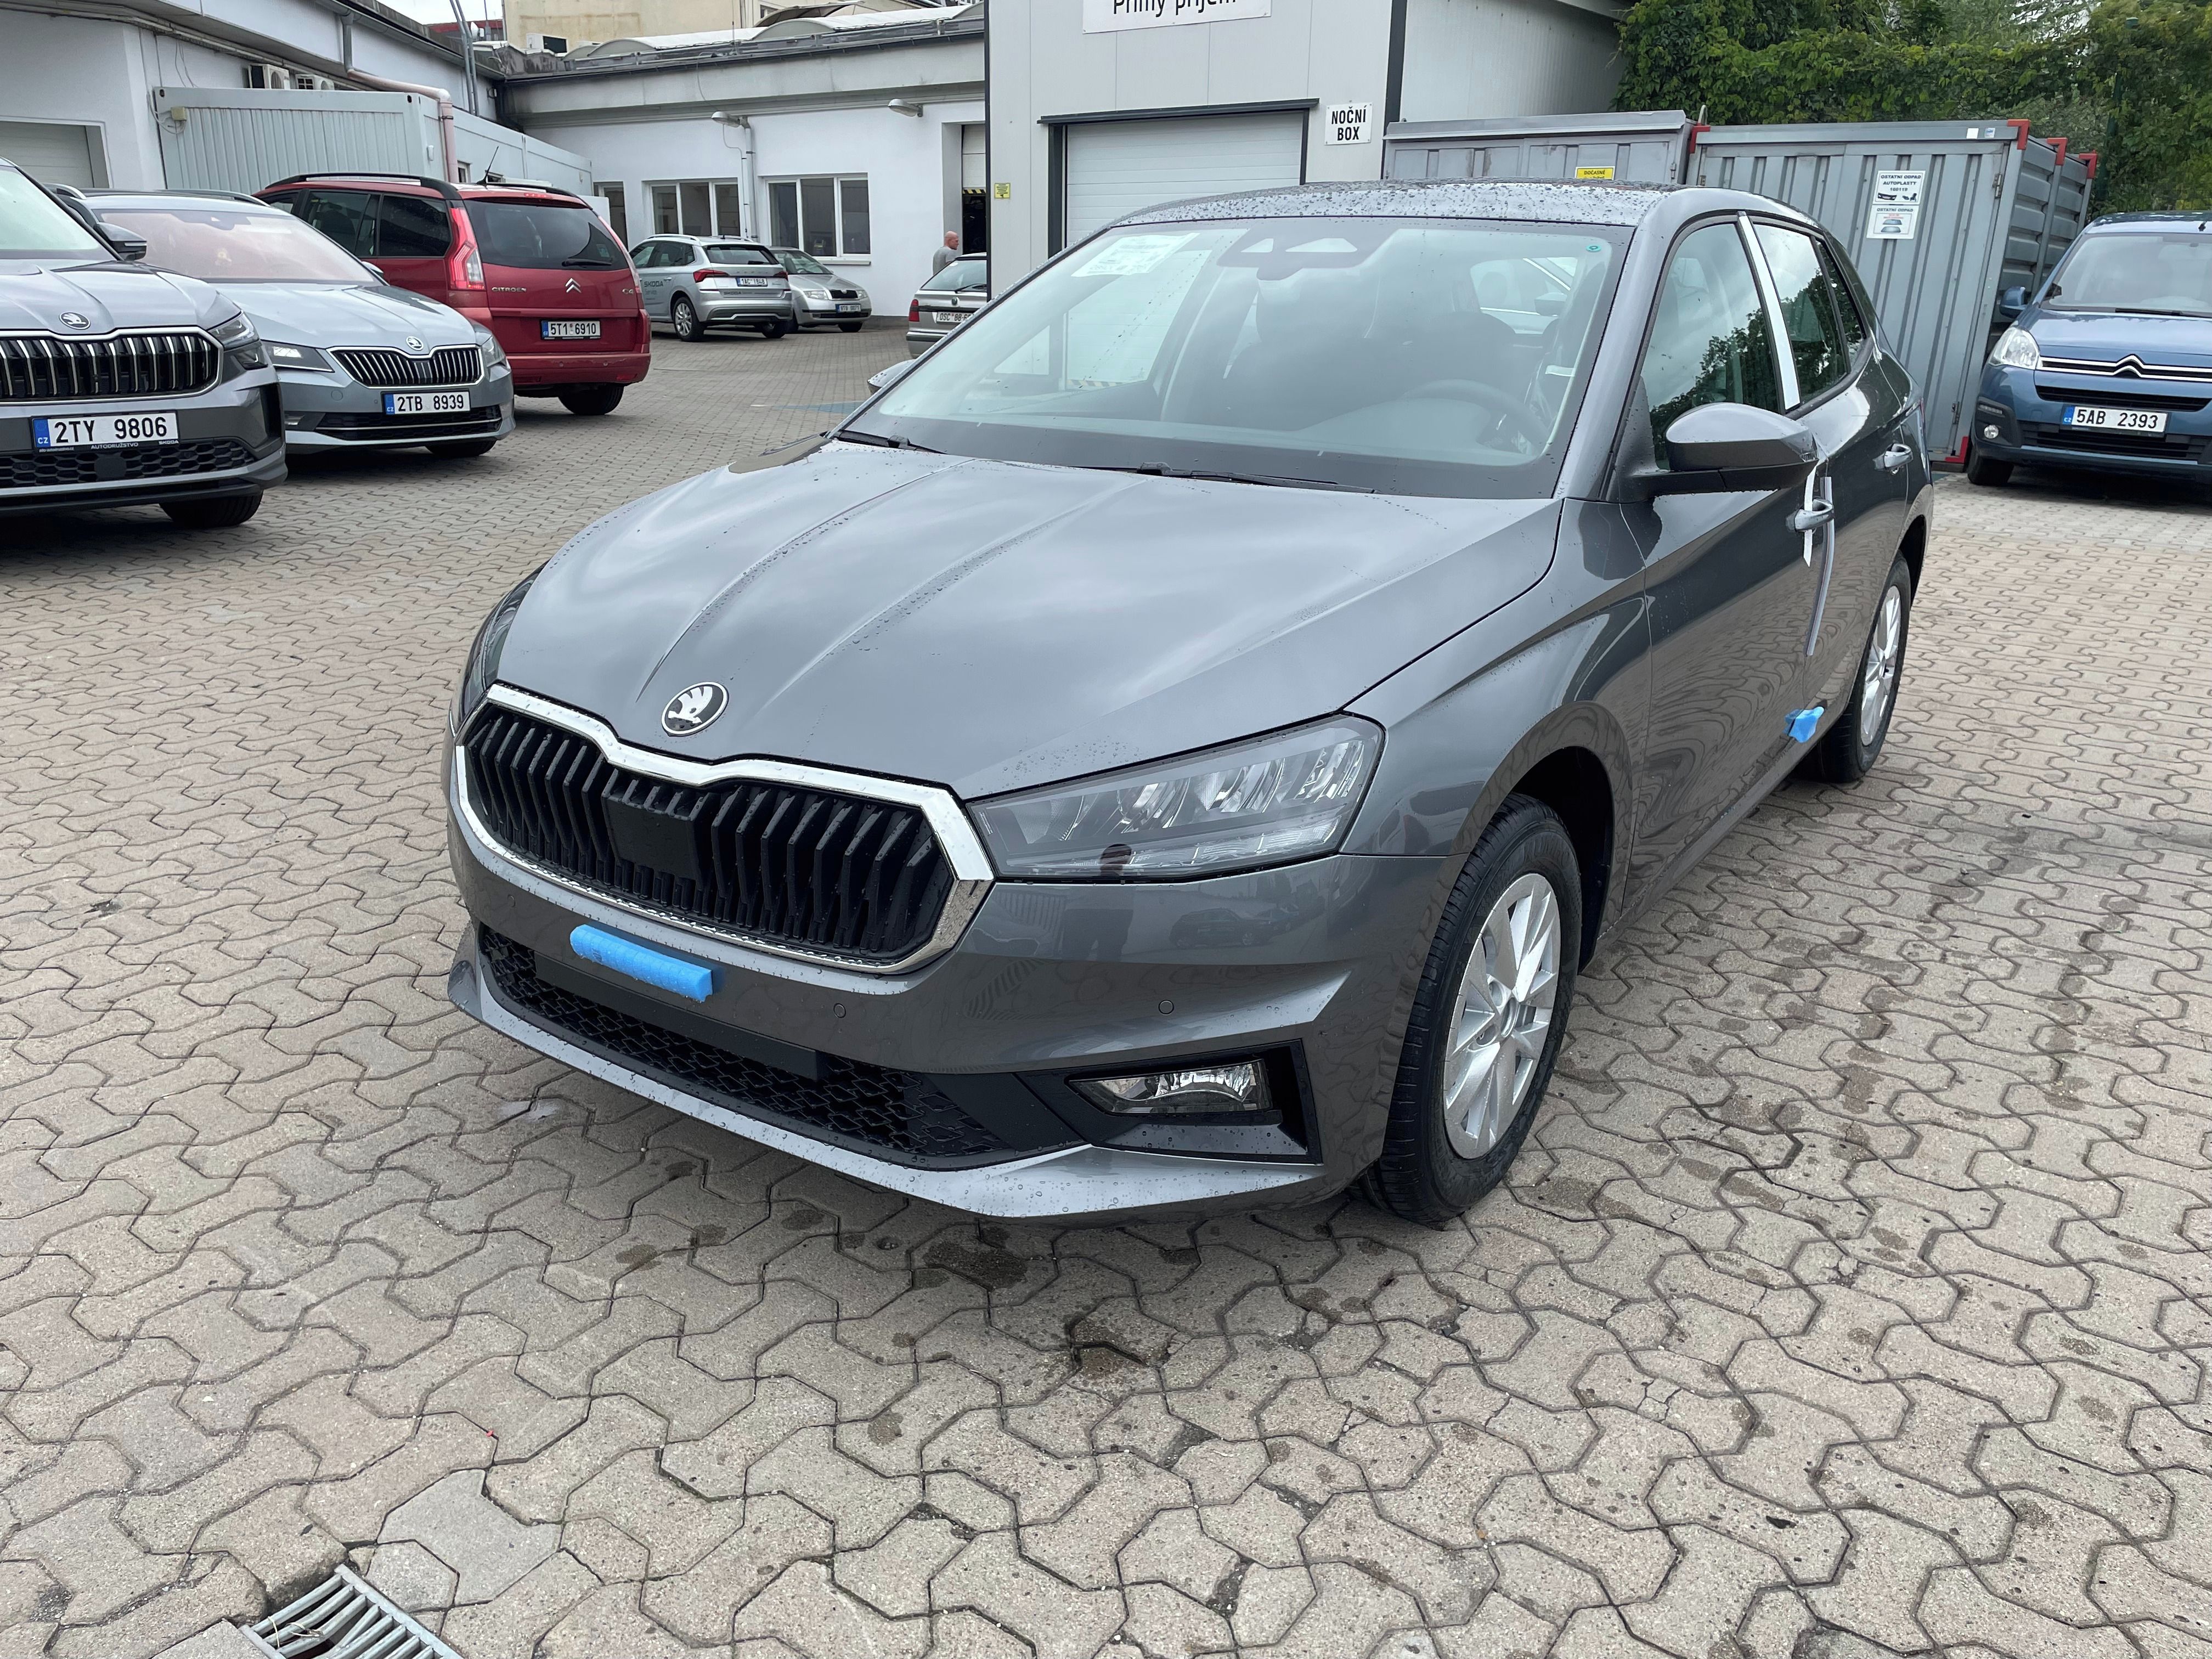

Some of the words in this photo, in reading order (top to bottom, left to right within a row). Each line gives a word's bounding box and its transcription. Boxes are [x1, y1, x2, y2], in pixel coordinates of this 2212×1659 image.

[1331, 105, 1367, 125] NOČNÍ
[1337, 126, 1359, 140] BOX
[550, 323, 568, 335] 5T1
[574, 323, 596, 335] 6910
[397, 396, 423, 412] 2TB
[433, 394, 464, 410] 8939
[2076, 409, 2107, 425] 5AB
[2117, 412, 2158, 428] 2393
[54, 420, 95, 443] 2TY
[114, 416, 167, 439] 9806
